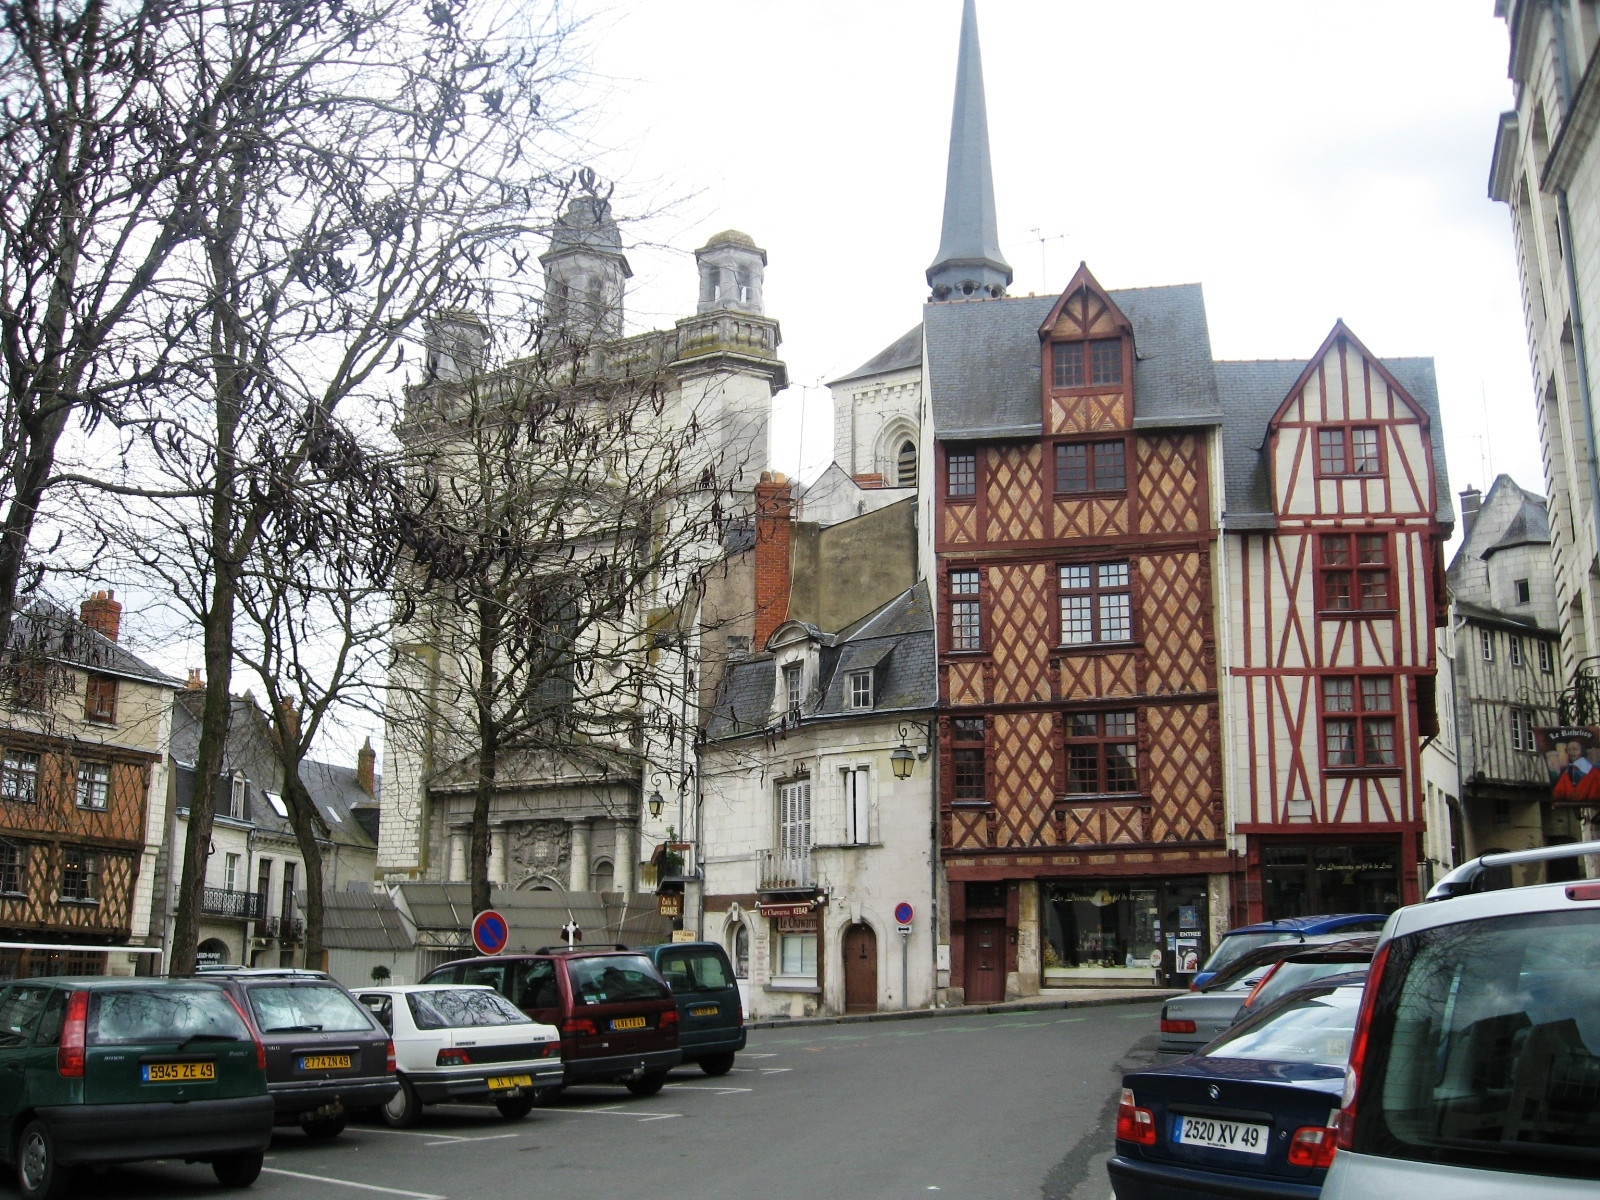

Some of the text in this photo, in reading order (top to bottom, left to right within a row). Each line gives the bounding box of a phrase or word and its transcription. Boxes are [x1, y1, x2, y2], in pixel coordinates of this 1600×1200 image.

[1549, 732, 1560, 740] Le
[793, 906, 808, 915] KEBAB
[789, 916, 817, 929] Chawarm
[304, 1055, 349, 1067] 2774 ZN 49
[150, 1064, 213, 1079] 5945 ZE 49
[1184, 1119, 1215, 1141] 2520
[1217, 1123, 1239, 1145] XV
[1241, 1126, 1259, 1148] 49
